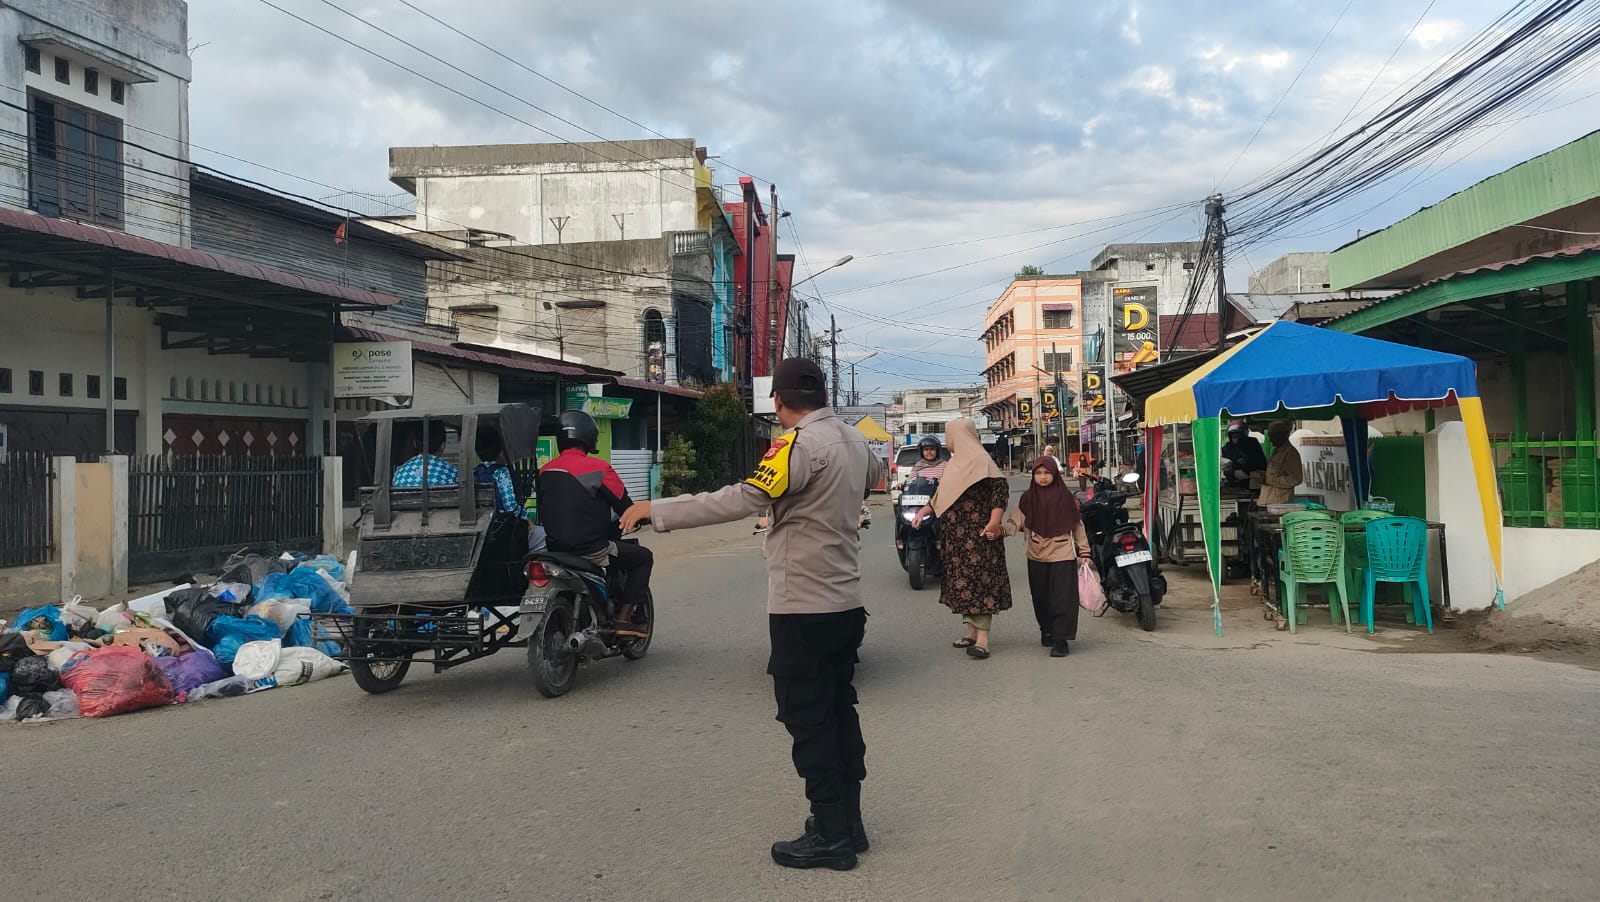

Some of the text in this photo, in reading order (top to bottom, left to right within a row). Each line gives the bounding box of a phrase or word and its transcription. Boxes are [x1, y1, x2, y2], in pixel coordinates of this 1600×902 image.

[1123, 303, 1149, 331] D
[1087, 373, 1101, 389] D
[1044, 393, 1055, 405] D
